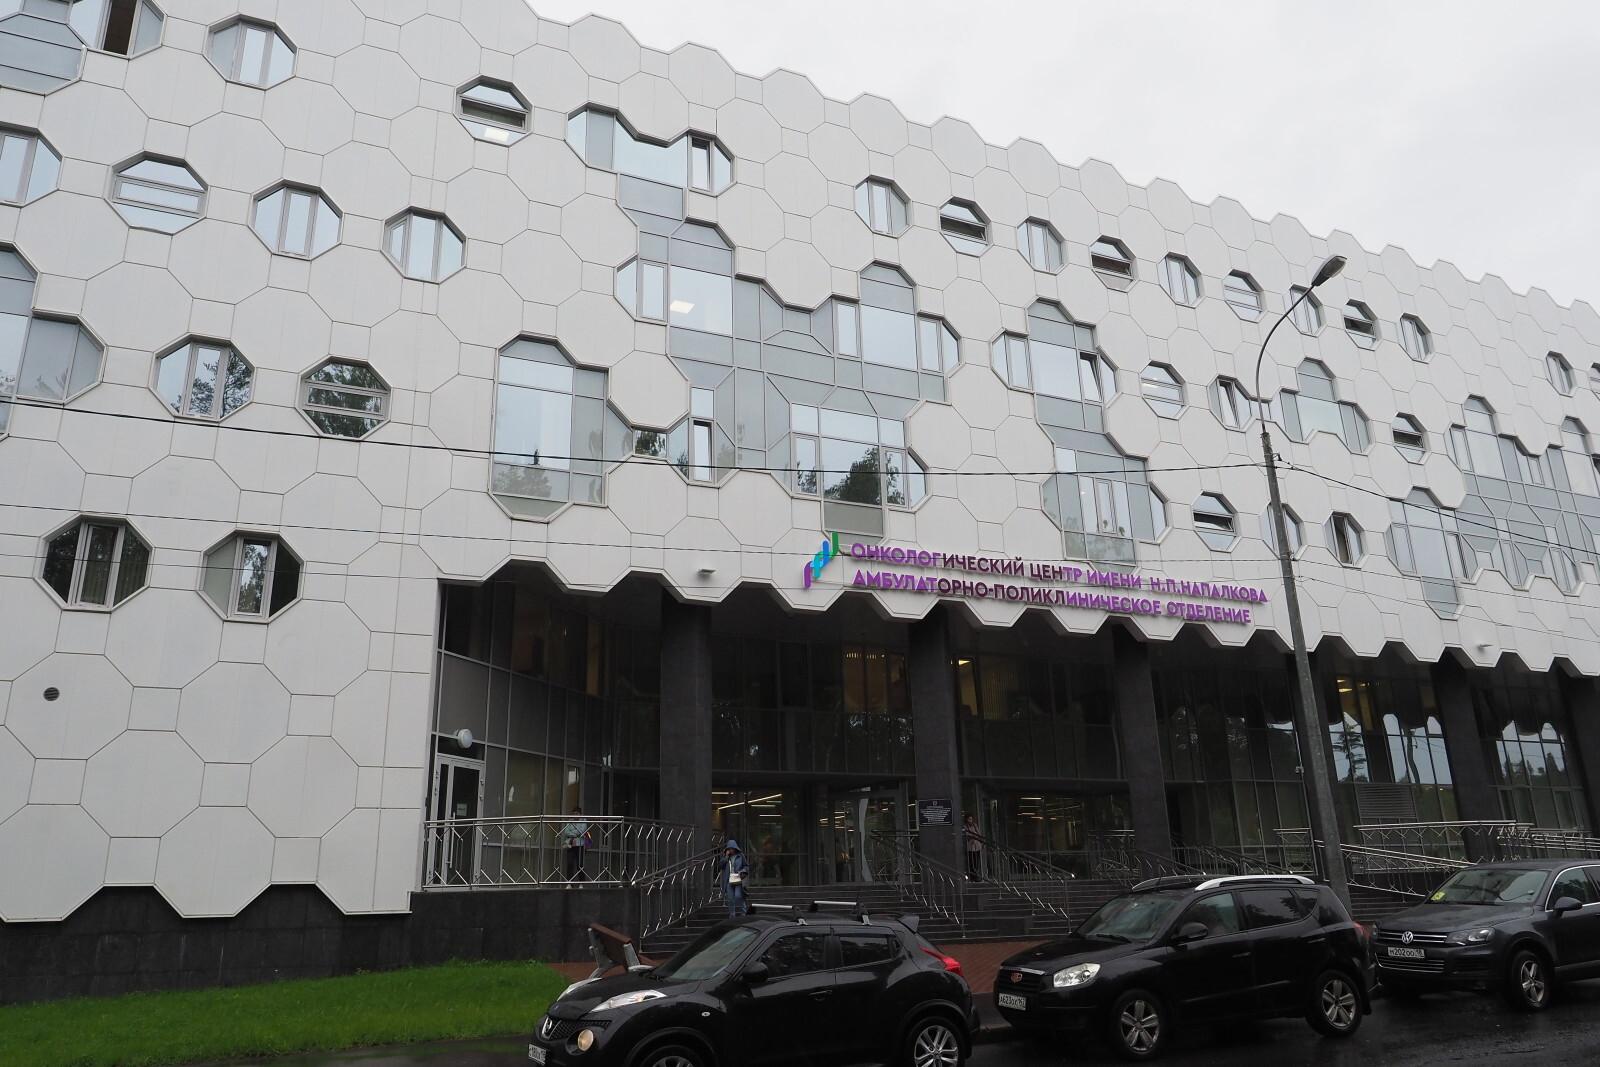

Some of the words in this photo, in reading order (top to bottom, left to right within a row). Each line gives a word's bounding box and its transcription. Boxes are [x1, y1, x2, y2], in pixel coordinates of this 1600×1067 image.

[851, 543, 1025, 576] ОНКОЛОГИЧЕСКИЙ
[1030, 562, 1083, 582] ЦЕНТР
[1087, 569, 1142, 588] ИМЕНИ
[853, 569, 1162, 615] АМБУЛАТОРНО-ПОЛИКЛИНИЧЕСКОЕ
[1166, 601, 1252, 623] ОТДЕЛЕНИЕ
